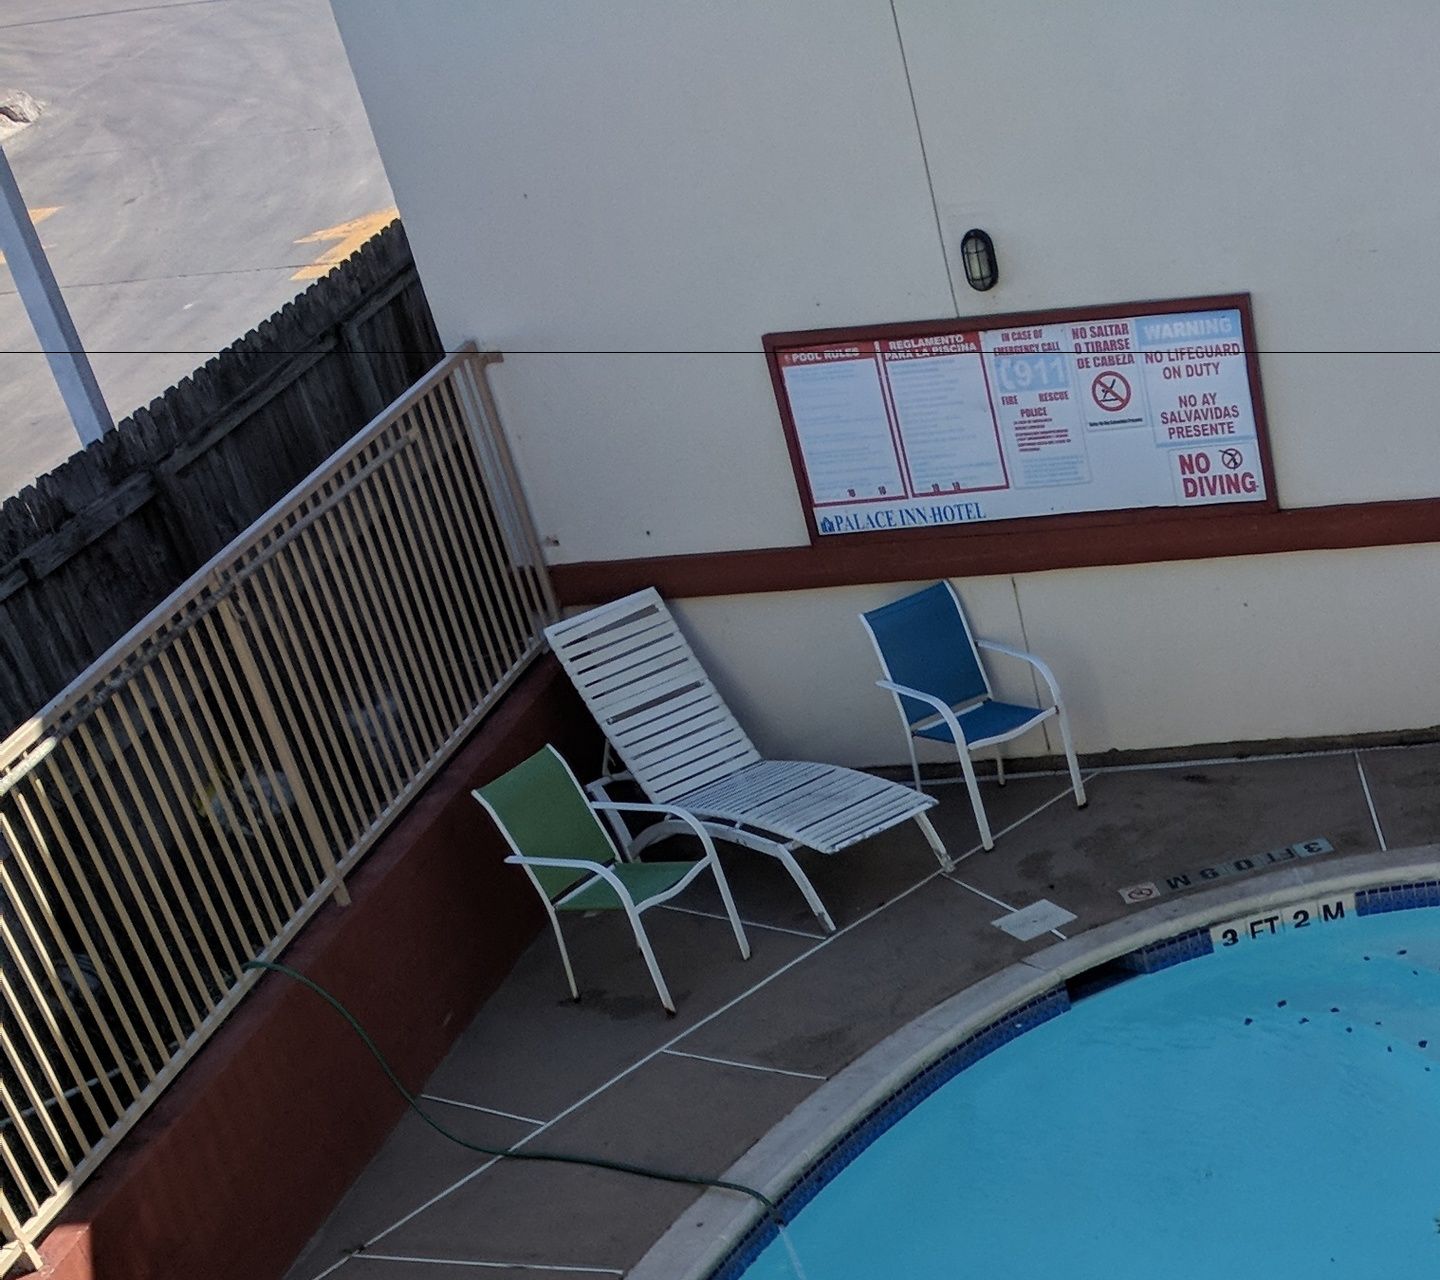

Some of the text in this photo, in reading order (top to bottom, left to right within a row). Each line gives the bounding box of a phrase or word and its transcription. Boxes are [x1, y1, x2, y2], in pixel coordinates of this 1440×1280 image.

[1012, 331, 1032, 341] CASE
[1072, 323, 1129, 340] NO SALTAR
[1144, 318, 1232, 339] WARNING
[889, 334, 963, 350] REGLAMENTO
[994, 341, 1061, 356] EMERGENCY CALL
[1074, 338, 1131, 353] O TIRARSE
[792, 347, 859, 364] POOL RULES
[885, 343, 977, 361] PARA LA PISCINA
[1145, 343, 1240, 364] NO LIFEGUARD
[1077, 353, 1135, 369] DE CABEZA
[1014, 357, 1066, 387] 911
[1163, 362, 1220, 379] ON DUTY
[1001, 395, 1019, 406] FIRE
[1038, 391, 1069, 402] RESCUE
[1178, 392, 1217, 408] NO AY
[1020, 407, 1048, 418] POLICE
[1160, 405, 1240, 425] SALVAVIDAS
[1168, 421, 1235, 439] PRESENTE
[1178, 452, 1211, 475] NO
[1182, 472, 1257, 498] DIVING
[834, 510, 896, 532] PALACE
[1266, 848, 1296, 864] FT
[1303, 842, 1323, 854] 3
[1165, 875, 1192, 890] M
[1222, 901, 1346, 947] 3 FT 2 M
